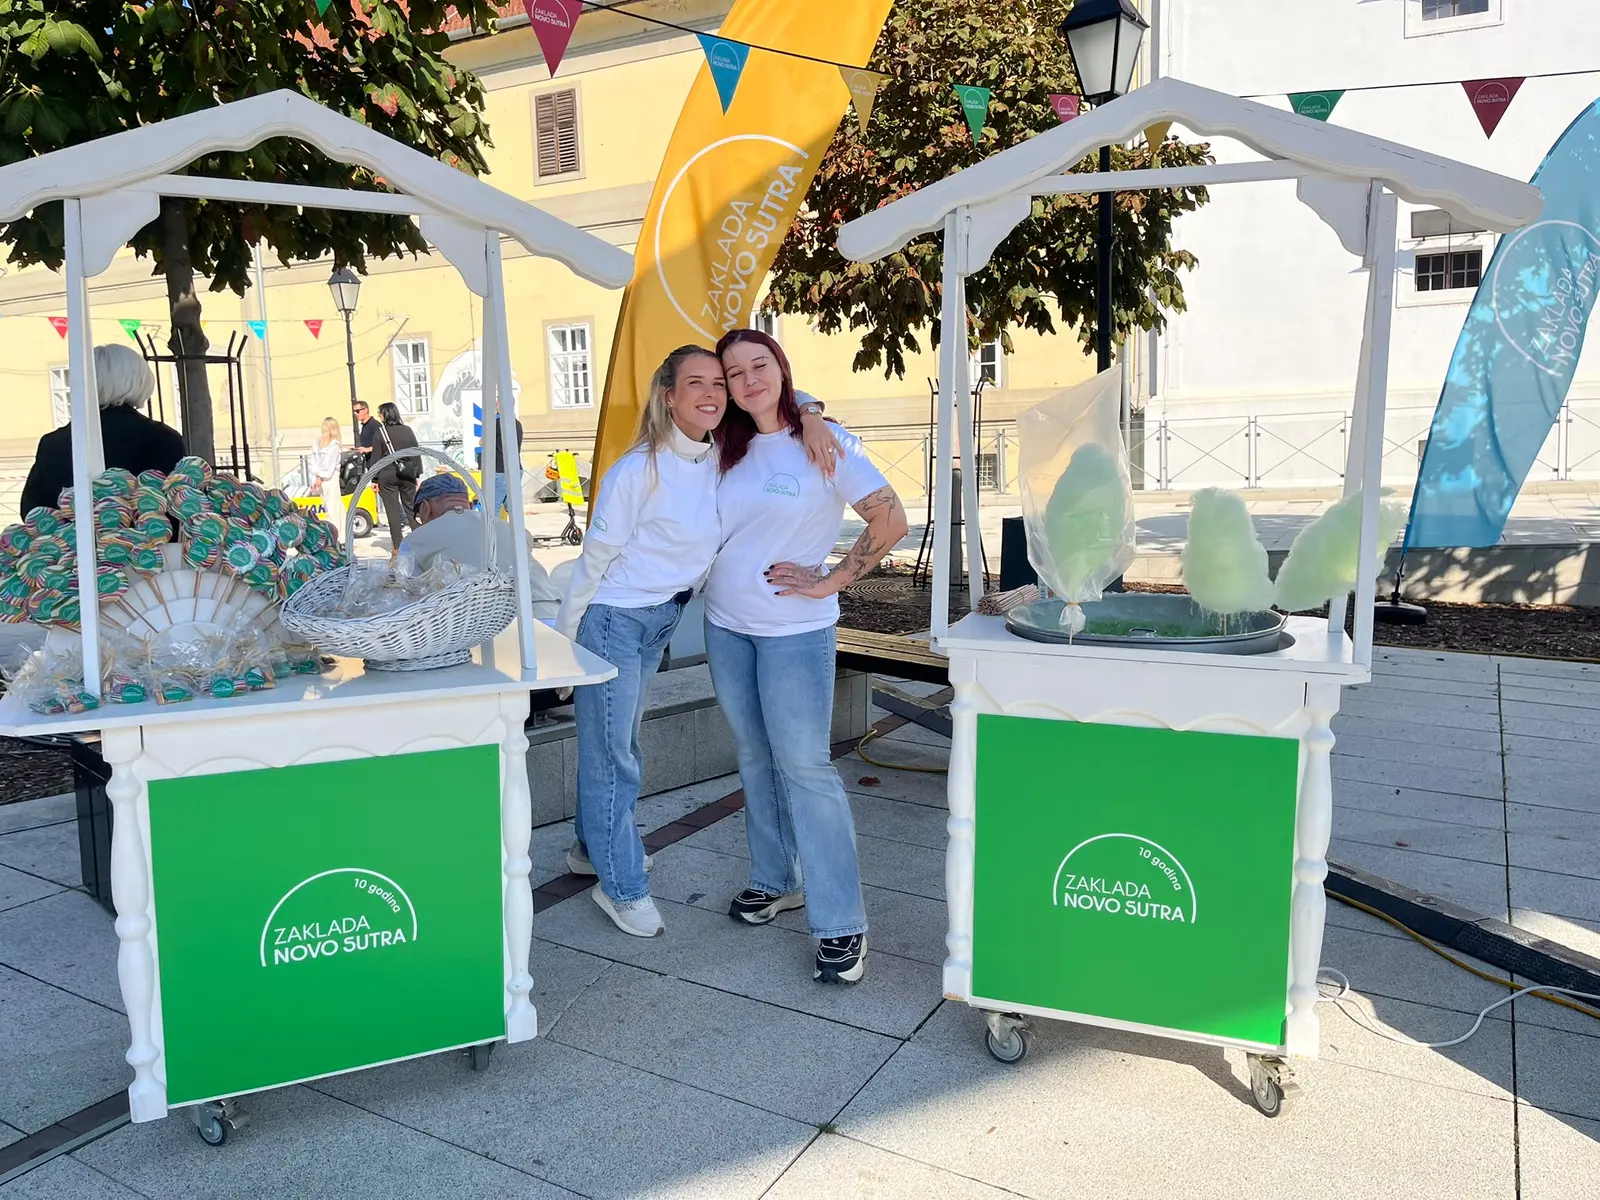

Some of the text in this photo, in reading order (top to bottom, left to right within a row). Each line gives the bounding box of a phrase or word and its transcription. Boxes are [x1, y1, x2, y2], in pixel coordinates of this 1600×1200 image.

[535, 7, 558, 19] ZAKLADA
[535, 14, 567, 28] NOVO SUTRA
[701, 201, 754, 324] ZAKLADA
[722, 165, 804, 332] NOVO SUTRA
[1531, 267, 1574, 354] ZAKLADA
[1550, 251, 1600, 366] NOVO SUTRA
[1065, 874, 1152, 899] ZAKLADA
[1139, 846, 1182, 891] 10 godina
[354, 878, 401, 914] 10 godina
[1064, 892, 1185, 922] NOVO SUTRA
[273, 915, 371, 946] ZAKLADA
[273, 928, 407, 965] NOVO SUTRA
